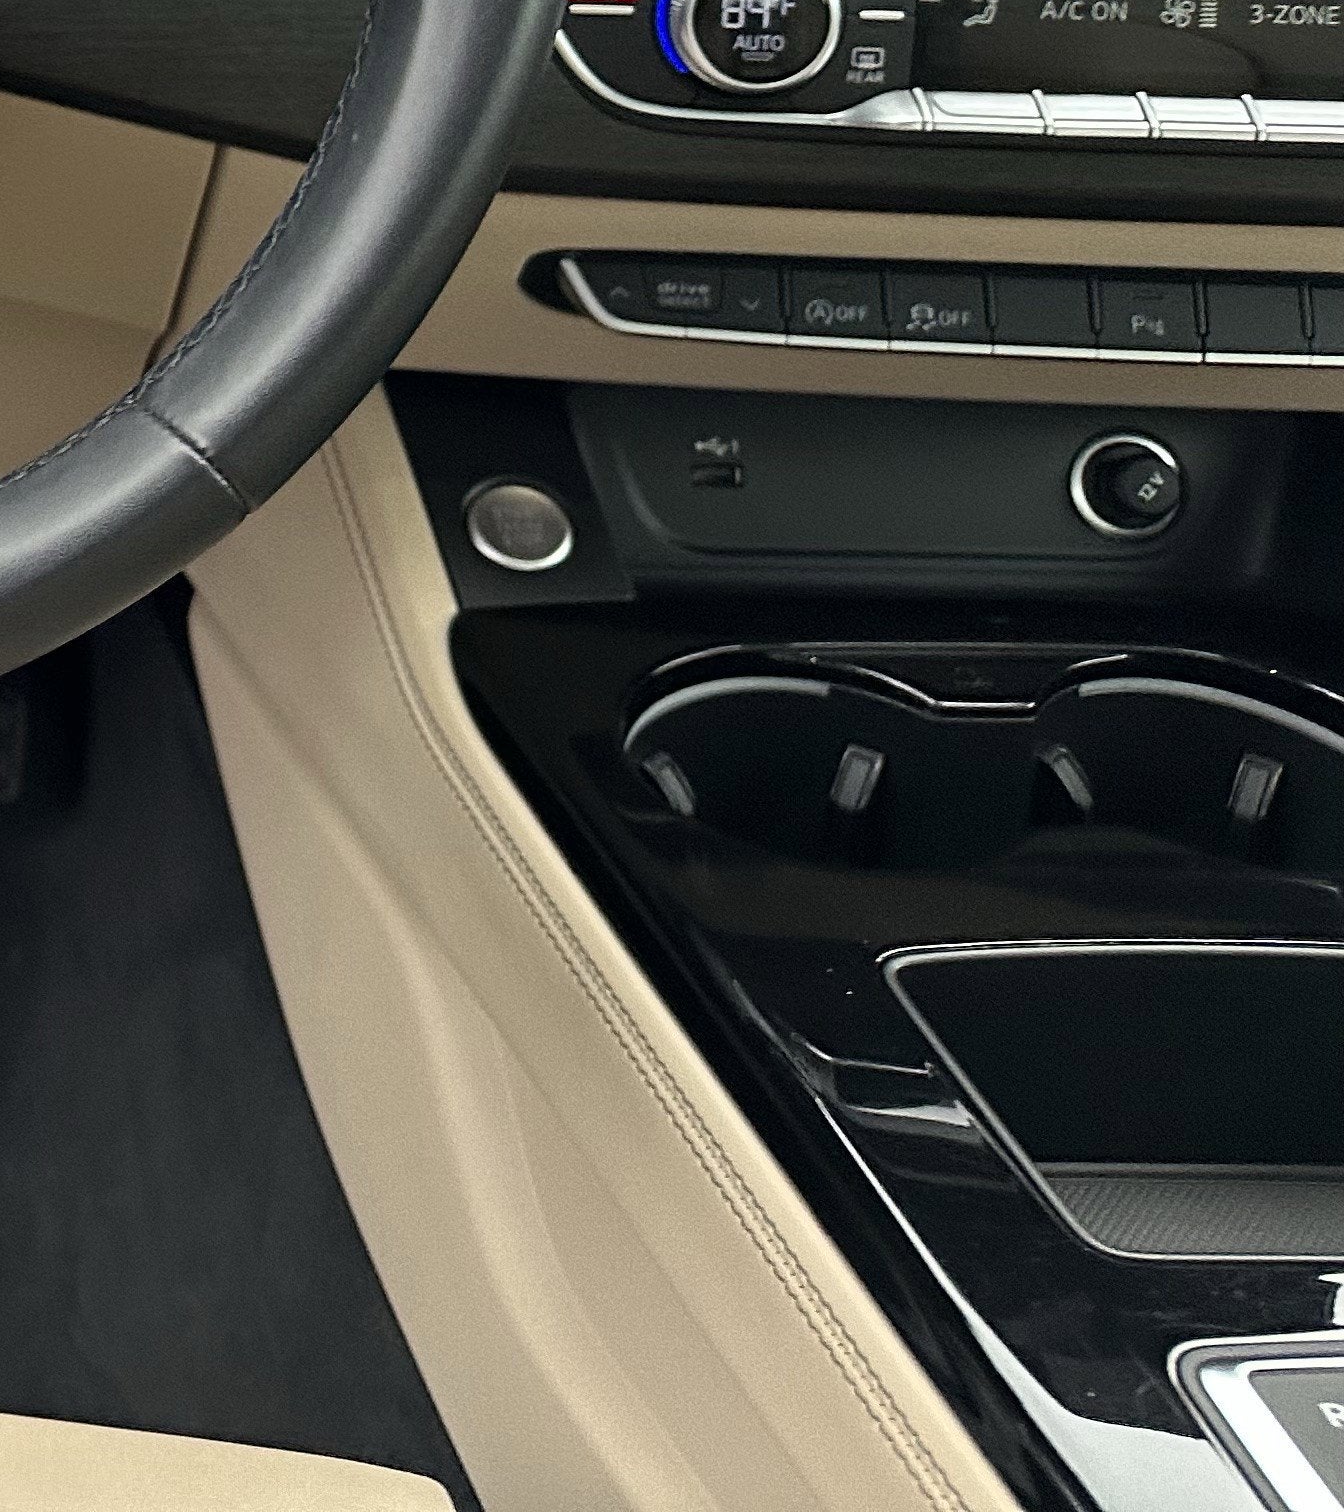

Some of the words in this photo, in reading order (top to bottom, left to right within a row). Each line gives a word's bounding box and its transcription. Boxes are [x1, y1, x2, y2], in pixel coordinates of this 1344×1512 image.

[1039, 0, 1084, 21] A/C
[1090, 0, 1129, 22] ON
[1248, 2, 1342, 26] 3-ZONE
[732, 34, 786, 52] AUTO
[834, 303, 867, 322] OFF
[938, 308, 970, 326] OFF
